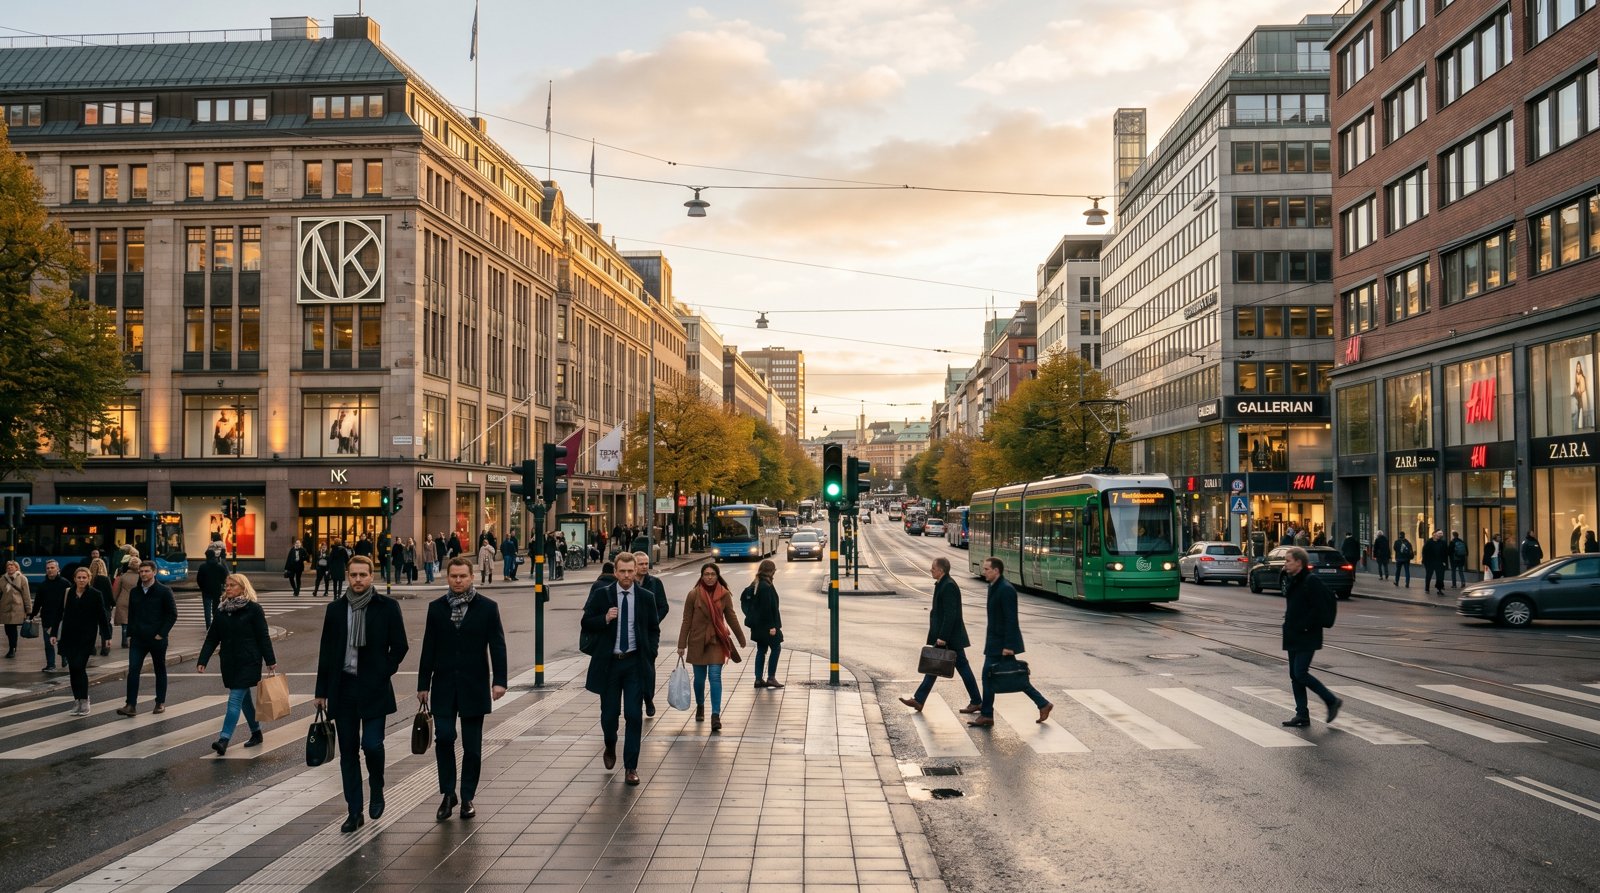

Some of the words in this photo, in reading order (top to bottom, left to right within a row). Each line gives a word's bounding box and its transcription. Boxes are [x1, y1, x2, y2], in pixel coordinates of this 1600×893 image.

[302, 217, 382, 301] NK
[1237, 401, 1313, 413] GALLERIAN
[1464, 377, 1496, 424] H&M
[1471, 446, 1487, 468] H&M
[1549, 441, 1591, 460] ZARA
[1395, 456, 1418, 469] ZARA
[330, 469, 348, 482] NK
[420, 474, 434, 487] NK
[1293, 475, 1316, 490] H&M
[1112, 492, 1119, 504] 7
